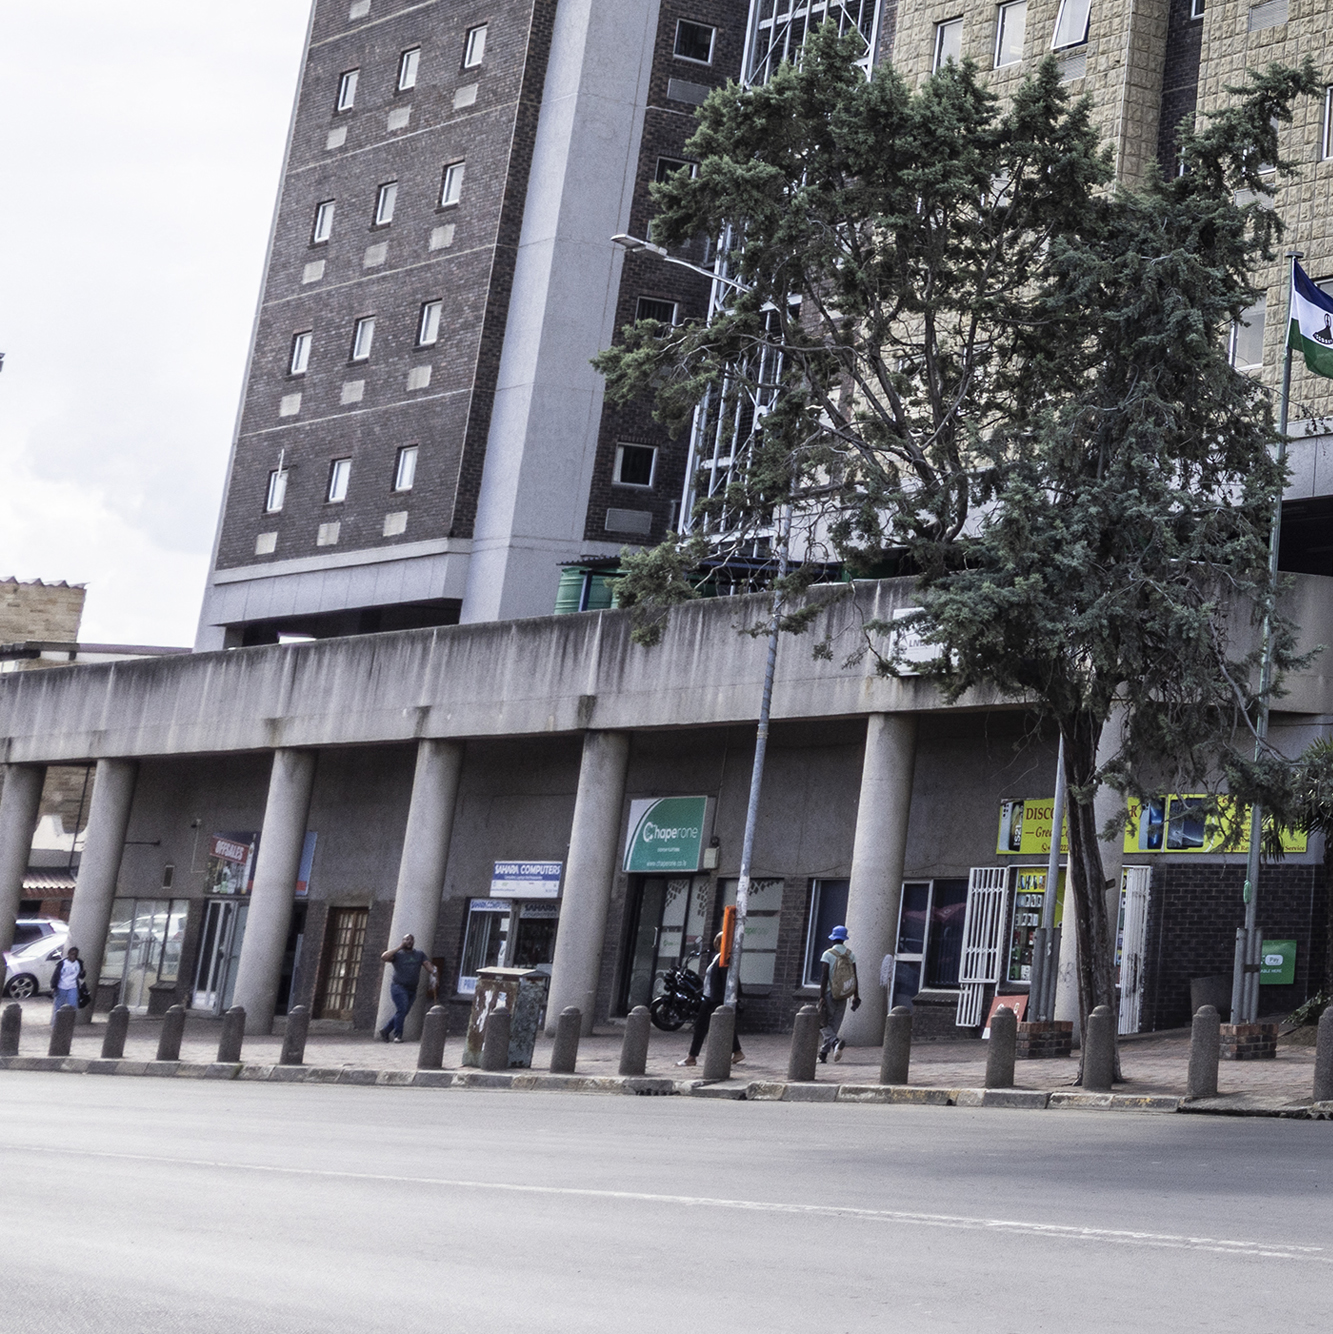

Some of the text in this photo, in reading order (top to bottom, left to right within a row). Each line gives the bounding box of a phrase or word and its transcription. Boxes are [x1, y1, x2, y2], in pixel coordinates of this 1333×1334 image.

[643, 821, 698, 842] Chaperone
[495, 864, 560, 875] SAHARA COMPUTERS
